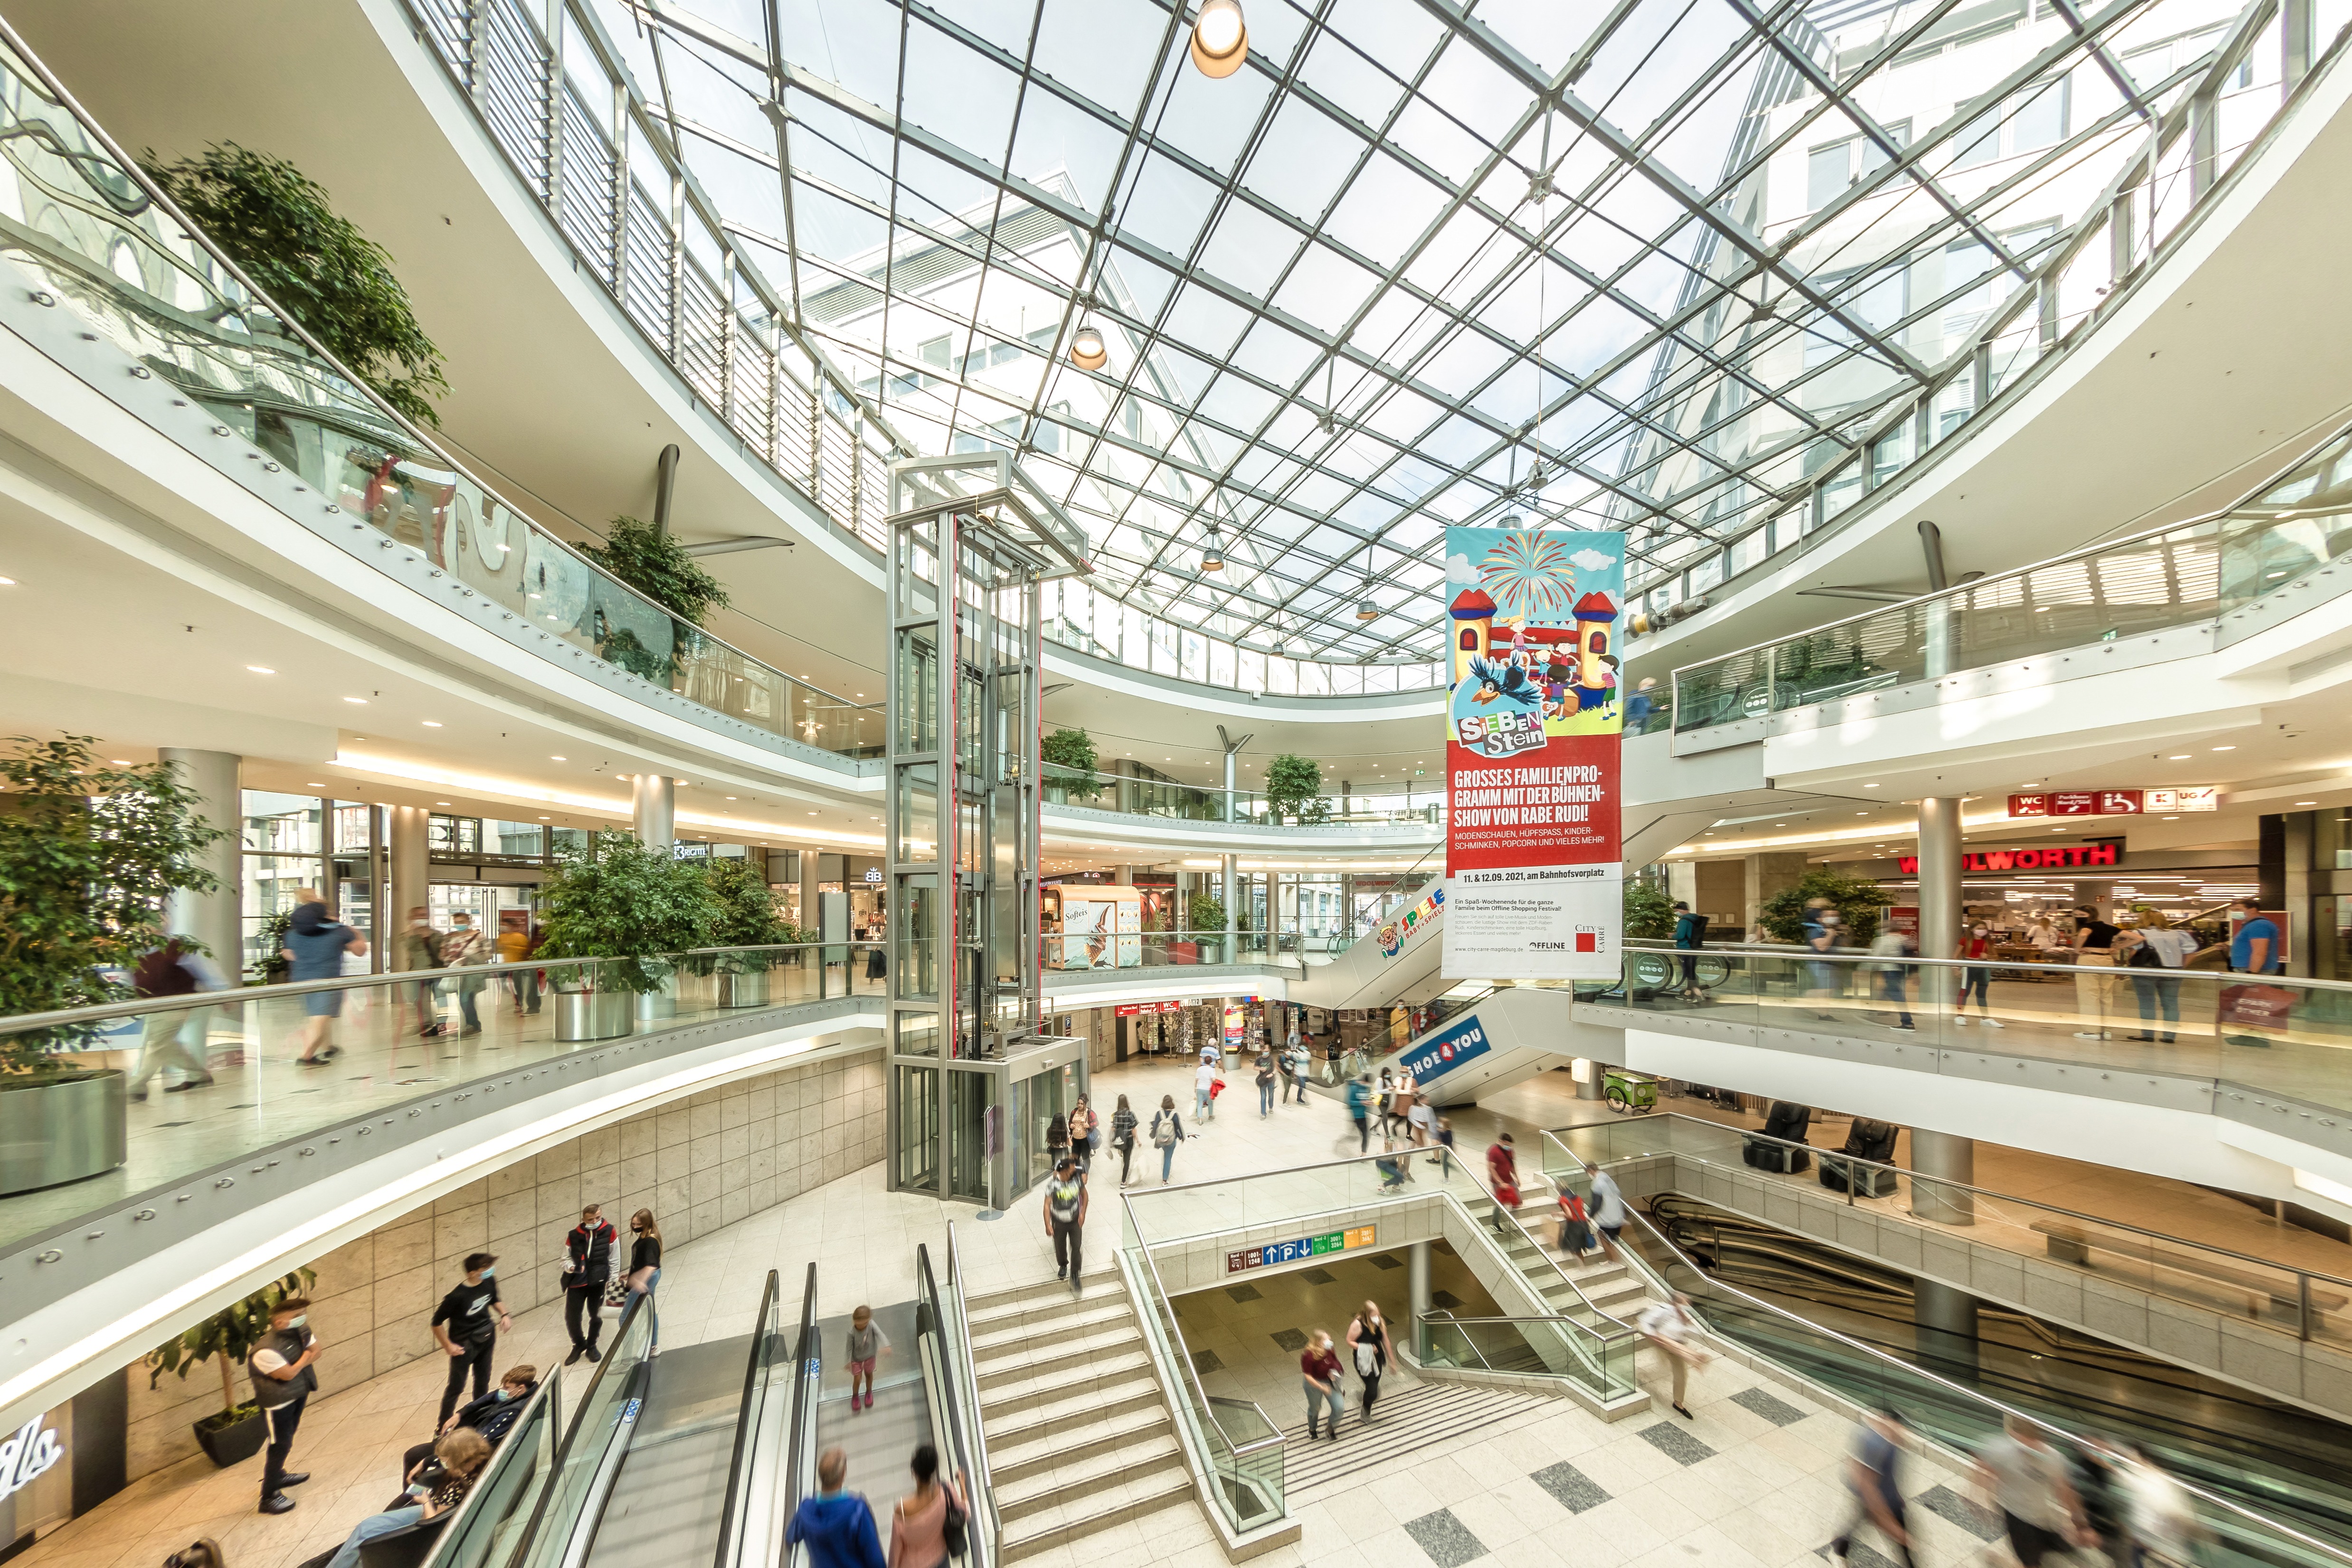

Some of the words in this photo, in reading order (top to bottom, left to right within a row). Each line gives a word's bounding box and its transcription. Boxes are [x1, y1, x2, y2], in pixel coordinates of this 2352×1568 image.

[1487, 730, 1544, 754] Stein
[1455, 768, 1512, 788] GROSSES
[1514, 765, 1603, 785] FAMILIENPRO-
[1455, 789, 1501, 807] GRAMM
[1503, 788, 1526, 805] MIT
[1527, 787, 1549, 804] DER
[1551, 783, 1605, 803] BÜHNEN-
[1454, 808, 1491, 827] SHOW
[1492, 808, 1518, 825] VON
[1521, 806, 1553, 824] RABE
[1555, 804, 1588, 822] RUDI!
[1455, 830, 1517, 840] MODENSCHAUEN,
[1519, 828, 1563, 837] HÜPFSPASS,
[1565, 827, 1593, 835] KINDER-
[1455, 841, 1500, 850] SCHMINKEN,
[1502, 839, 1536, 848] POPCORN
[1555, 837, 1580, 845] VIELES
[1582, 836, 1604, 844] MEHR!
[1898, 844, 2115, 874] WLWORTH
[1463, 875, 1473, 883] 11.
[1474, 874, 1480, 882] &
[1481, 873, 1504, 882] 12.09.
[1505, 872, 1526, 881] 2021,
[1540, 869, 1604, 879] Bahnhofsvorplatz
[1065, 908, 1088, 921] Softeis
[1401, 888, 1445, 932] SPIELE
[1284, 1247, 1293, 1260] P
